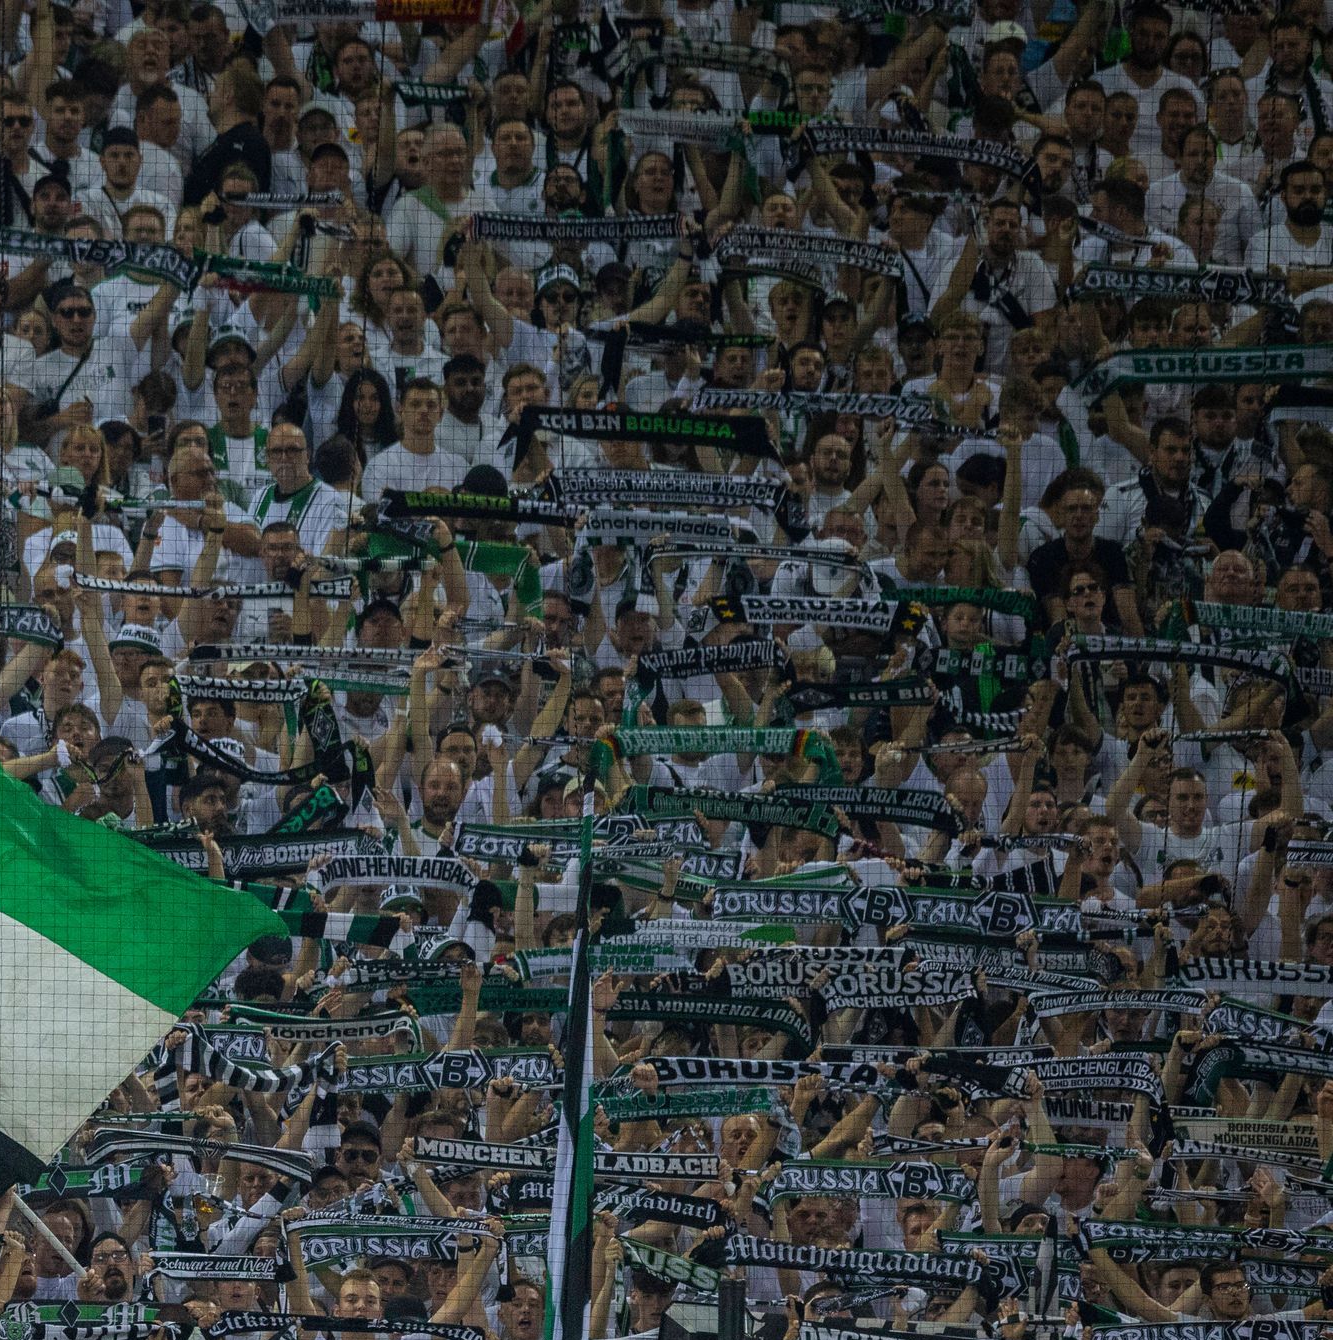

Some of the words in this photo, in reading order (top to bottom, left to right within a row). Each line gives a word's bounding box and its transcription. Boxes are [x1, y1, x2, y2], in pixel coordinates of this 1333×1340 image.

[541, 414, 576, 428] ICH
[584, 416, 620, 429] BIN
[264, 841, 358, 867] BORUSSIA
[823, 968, 973, 999] BORUSSIA
[853, 1051, 895, 1061] SEIT
[988, 1050, 1033, 1061] 1900
[1228, 1123, 1288, 1135] BORUSSIA
[1294, 1126, 1315, 1137] VFL
[214, 1260, 239, 1272] und
[242, 1259, 275, 1272] Weiß
